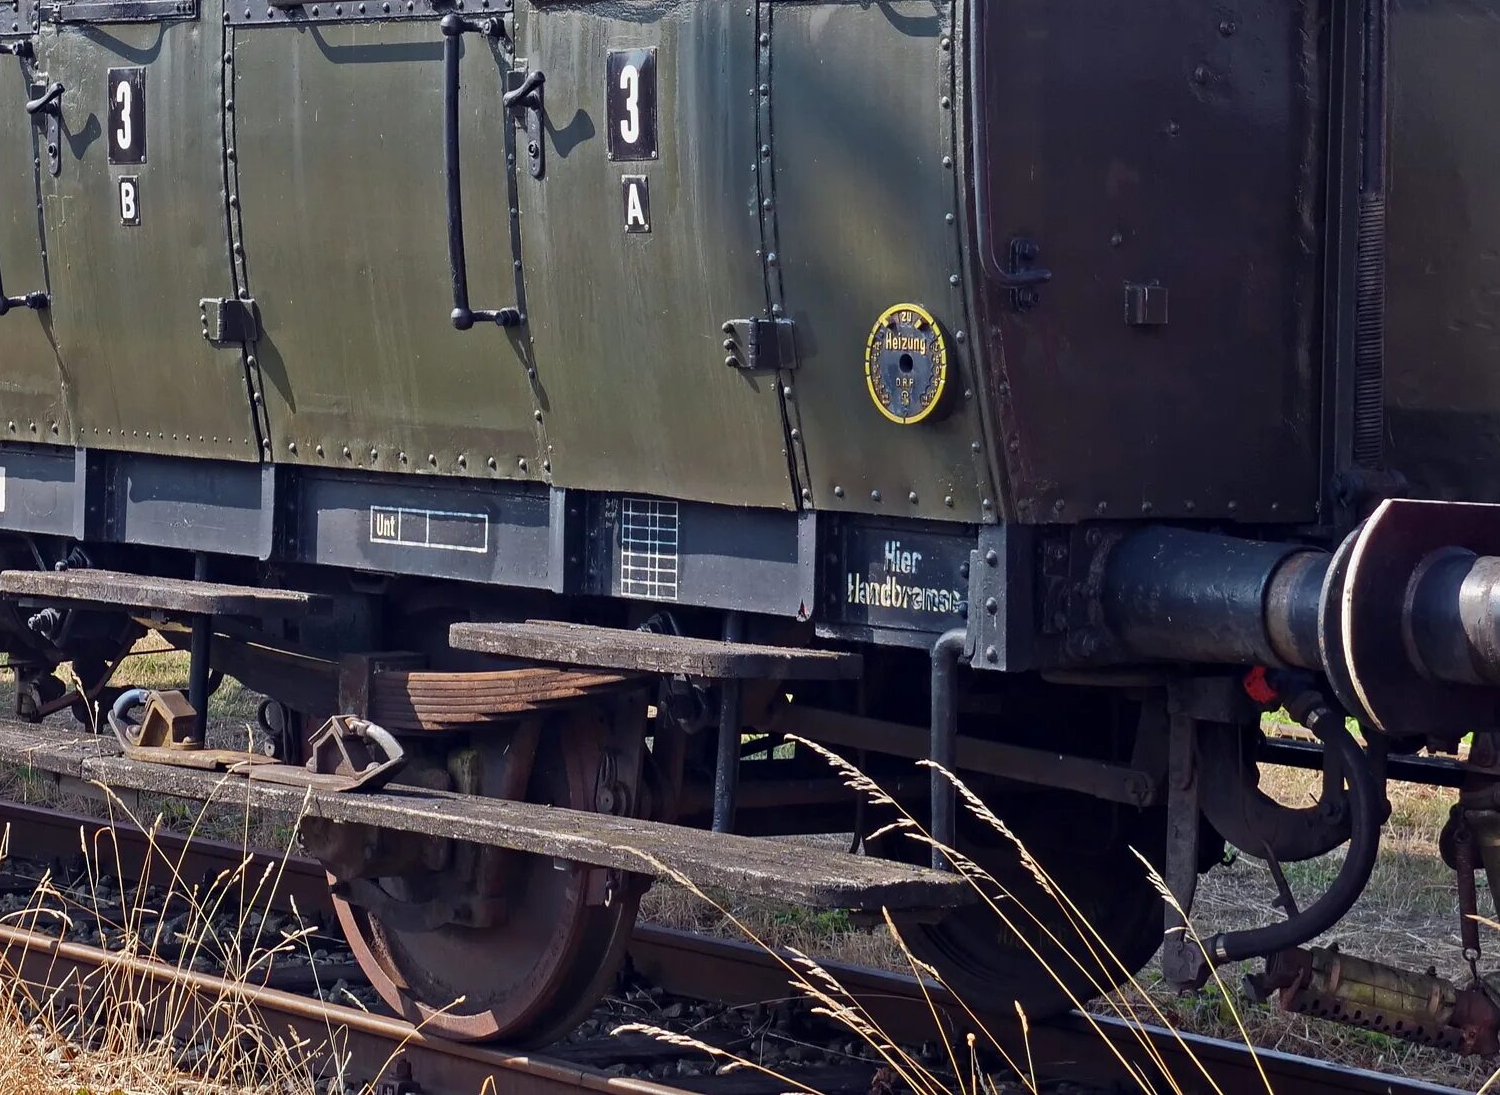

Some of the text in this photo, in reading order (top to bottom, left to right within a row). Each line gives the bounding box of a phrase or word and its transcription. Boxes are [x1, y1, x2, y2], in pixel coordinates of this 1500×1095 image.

[116, 80, 132, 150] 3
[610, 64, 640, 144] 3
[120, 182, 136, 219] B
[627, 183, 645, 225] A
[885, 331, 927, 355] Heizung
[376, 513, 395, 537] Unt
[883, 540, 922, 574] Hier
